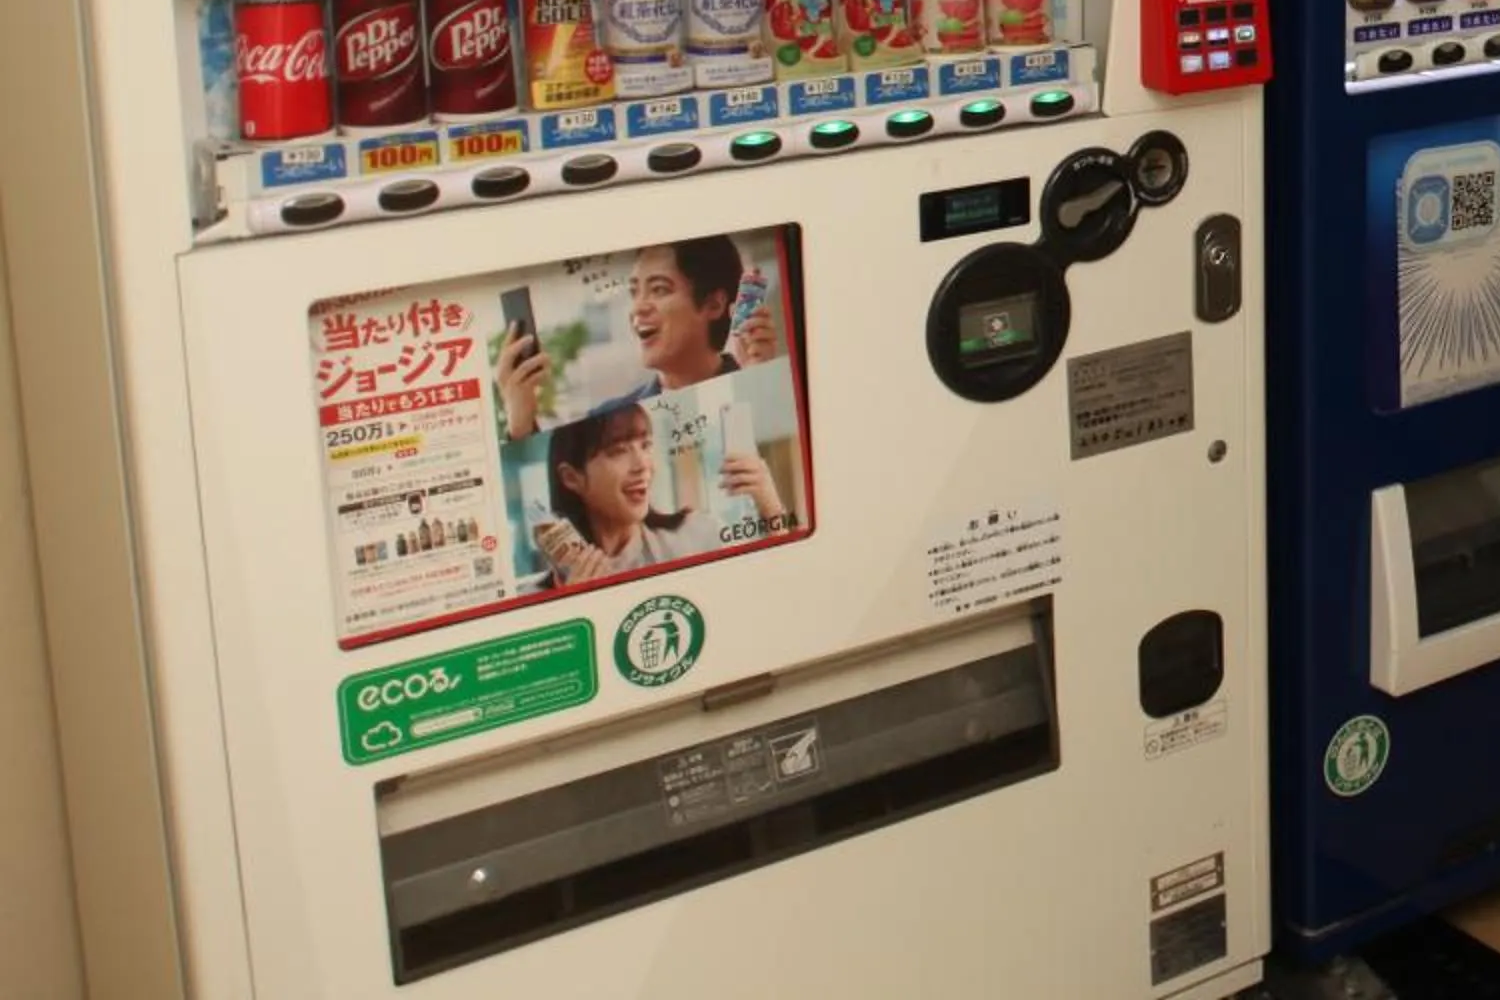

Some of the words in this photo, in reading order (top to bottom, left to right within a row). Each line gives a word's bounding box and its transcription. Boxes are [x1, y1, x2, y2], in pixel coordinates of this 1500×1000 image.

[367, 13, 400, 47] Dr
[1358, 26, 1397, 41] つめたい
[1411, 20, 1449, 34] つめたい
[1463, 14, 1500, 28] つめたい
[347, 24, 415, 72] Pepper
[450, 14, 507, 62] Pepp
[324, 298, 464, 351] 当たり付き
[317, 337, 473, 399] ジョージア
[326, 421, 383, 447] 250万
[719, 512, 800, 545] GEORGIA
